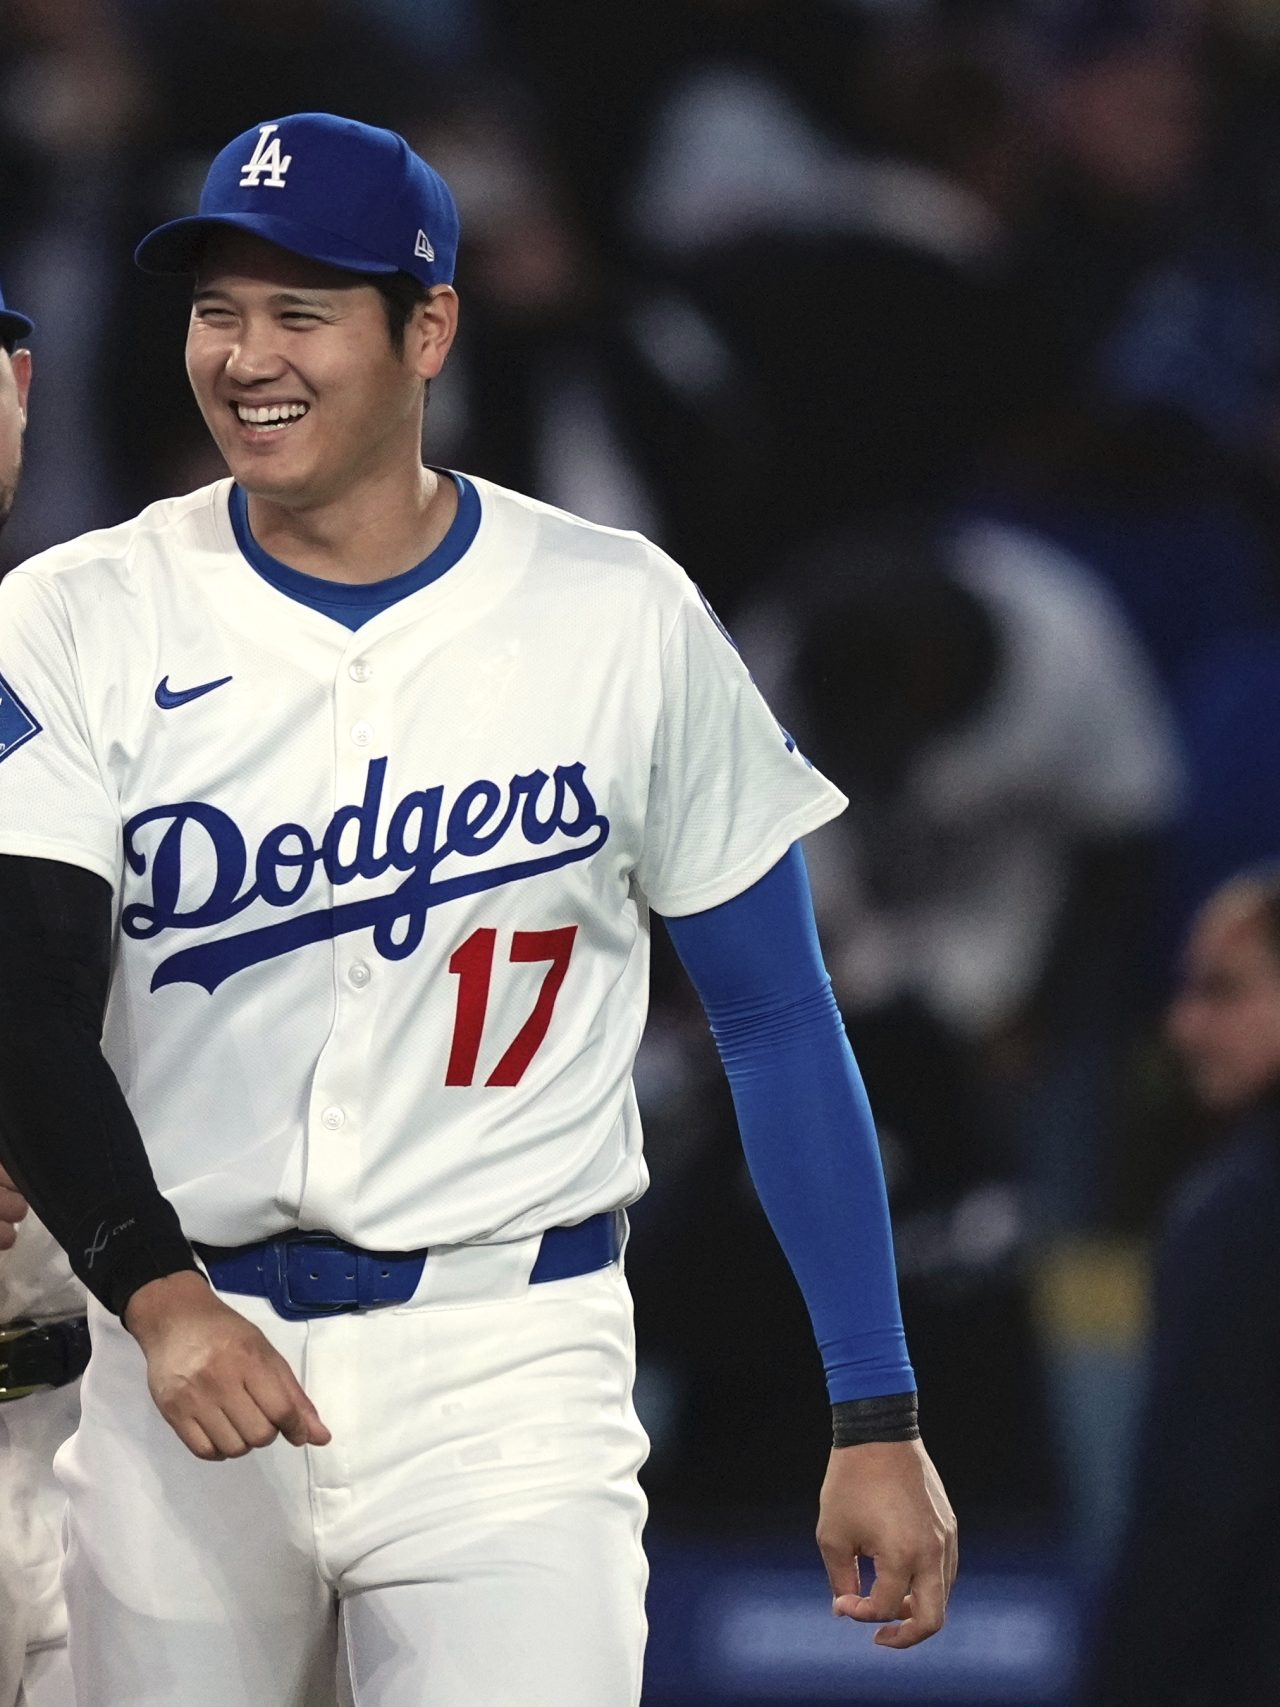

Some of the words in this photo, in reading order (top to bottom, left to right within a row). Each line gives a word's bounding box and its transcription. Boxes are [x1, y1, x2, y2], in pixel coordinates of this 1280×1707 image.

[239, 124, 292, 188] LA
[122, 756, 610, 964] Dodgers
[444, 925, 579, 1087] 17
